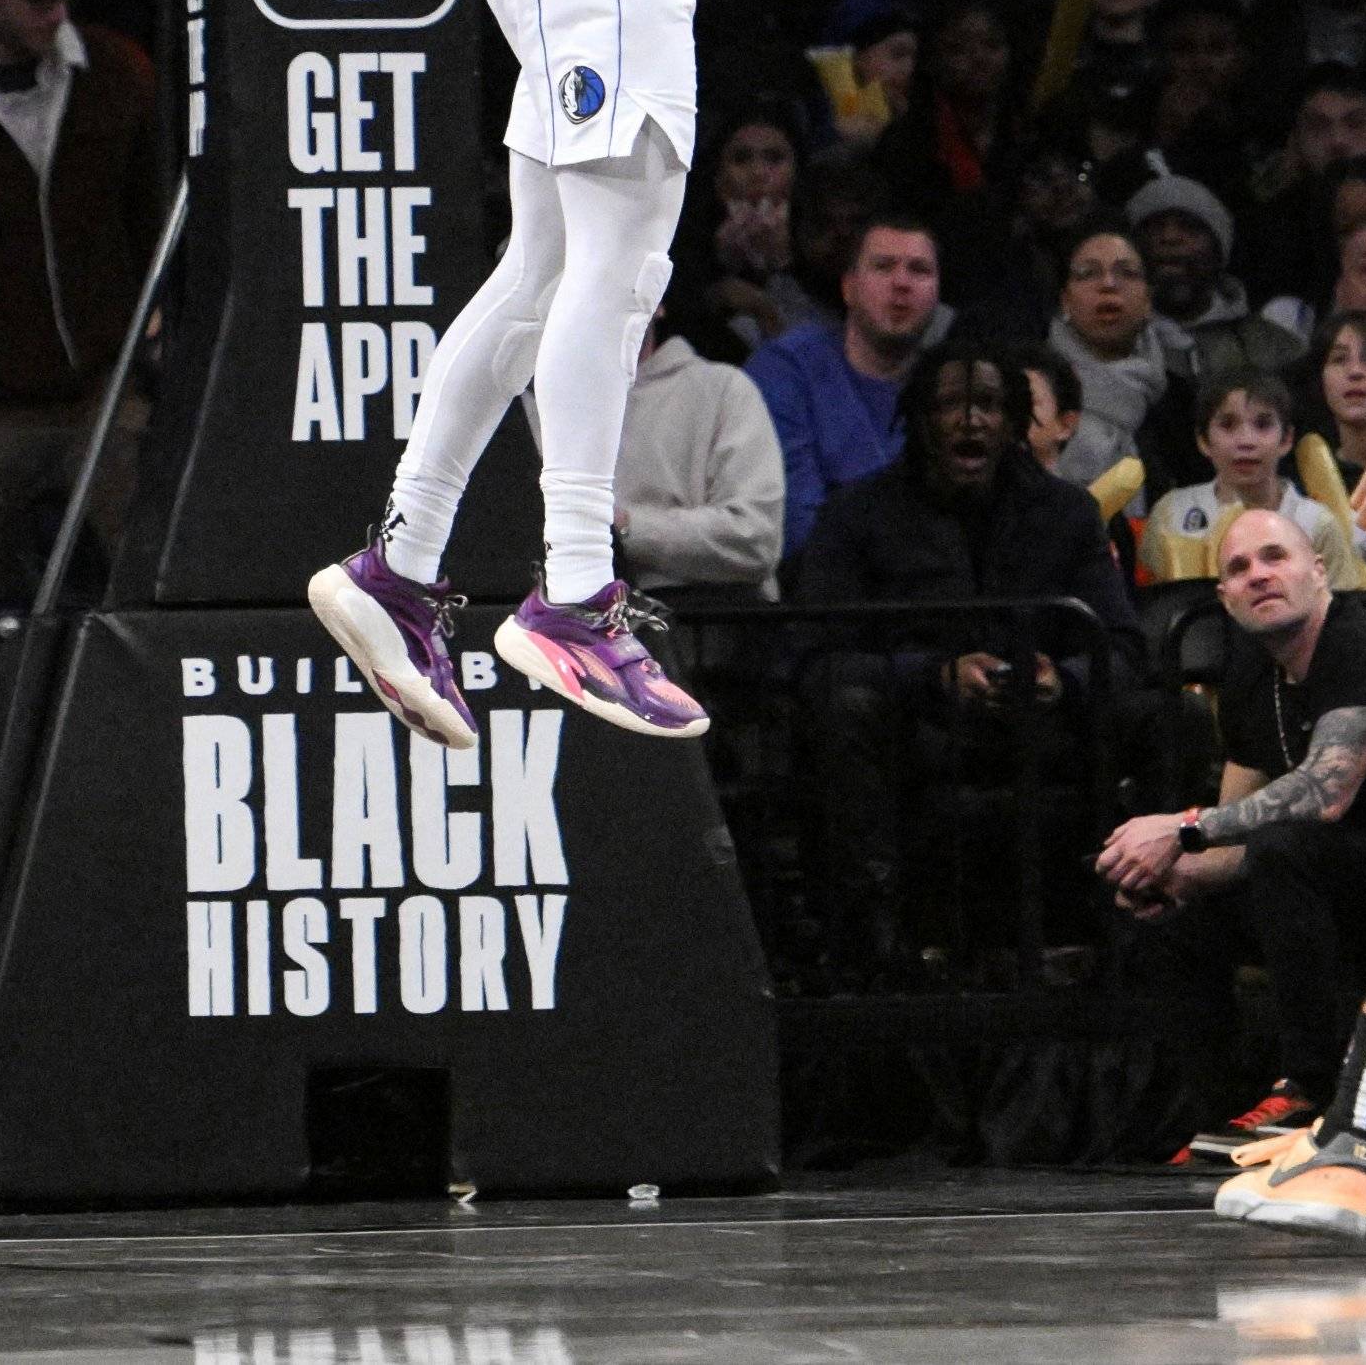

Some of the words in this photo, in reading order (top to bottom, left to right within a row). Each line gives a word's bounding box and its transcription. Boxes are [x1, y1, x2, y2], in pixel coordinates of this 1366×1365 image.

[286, 51, 427, 175] GET
[287, 186, 434, 307] THE
[291, 321, 438, 442] APP
[181, 655, 364, 697] BUIL
[183, 708, 570, 894] BLACK
[186, 894, 568, 1017] HISTORY
